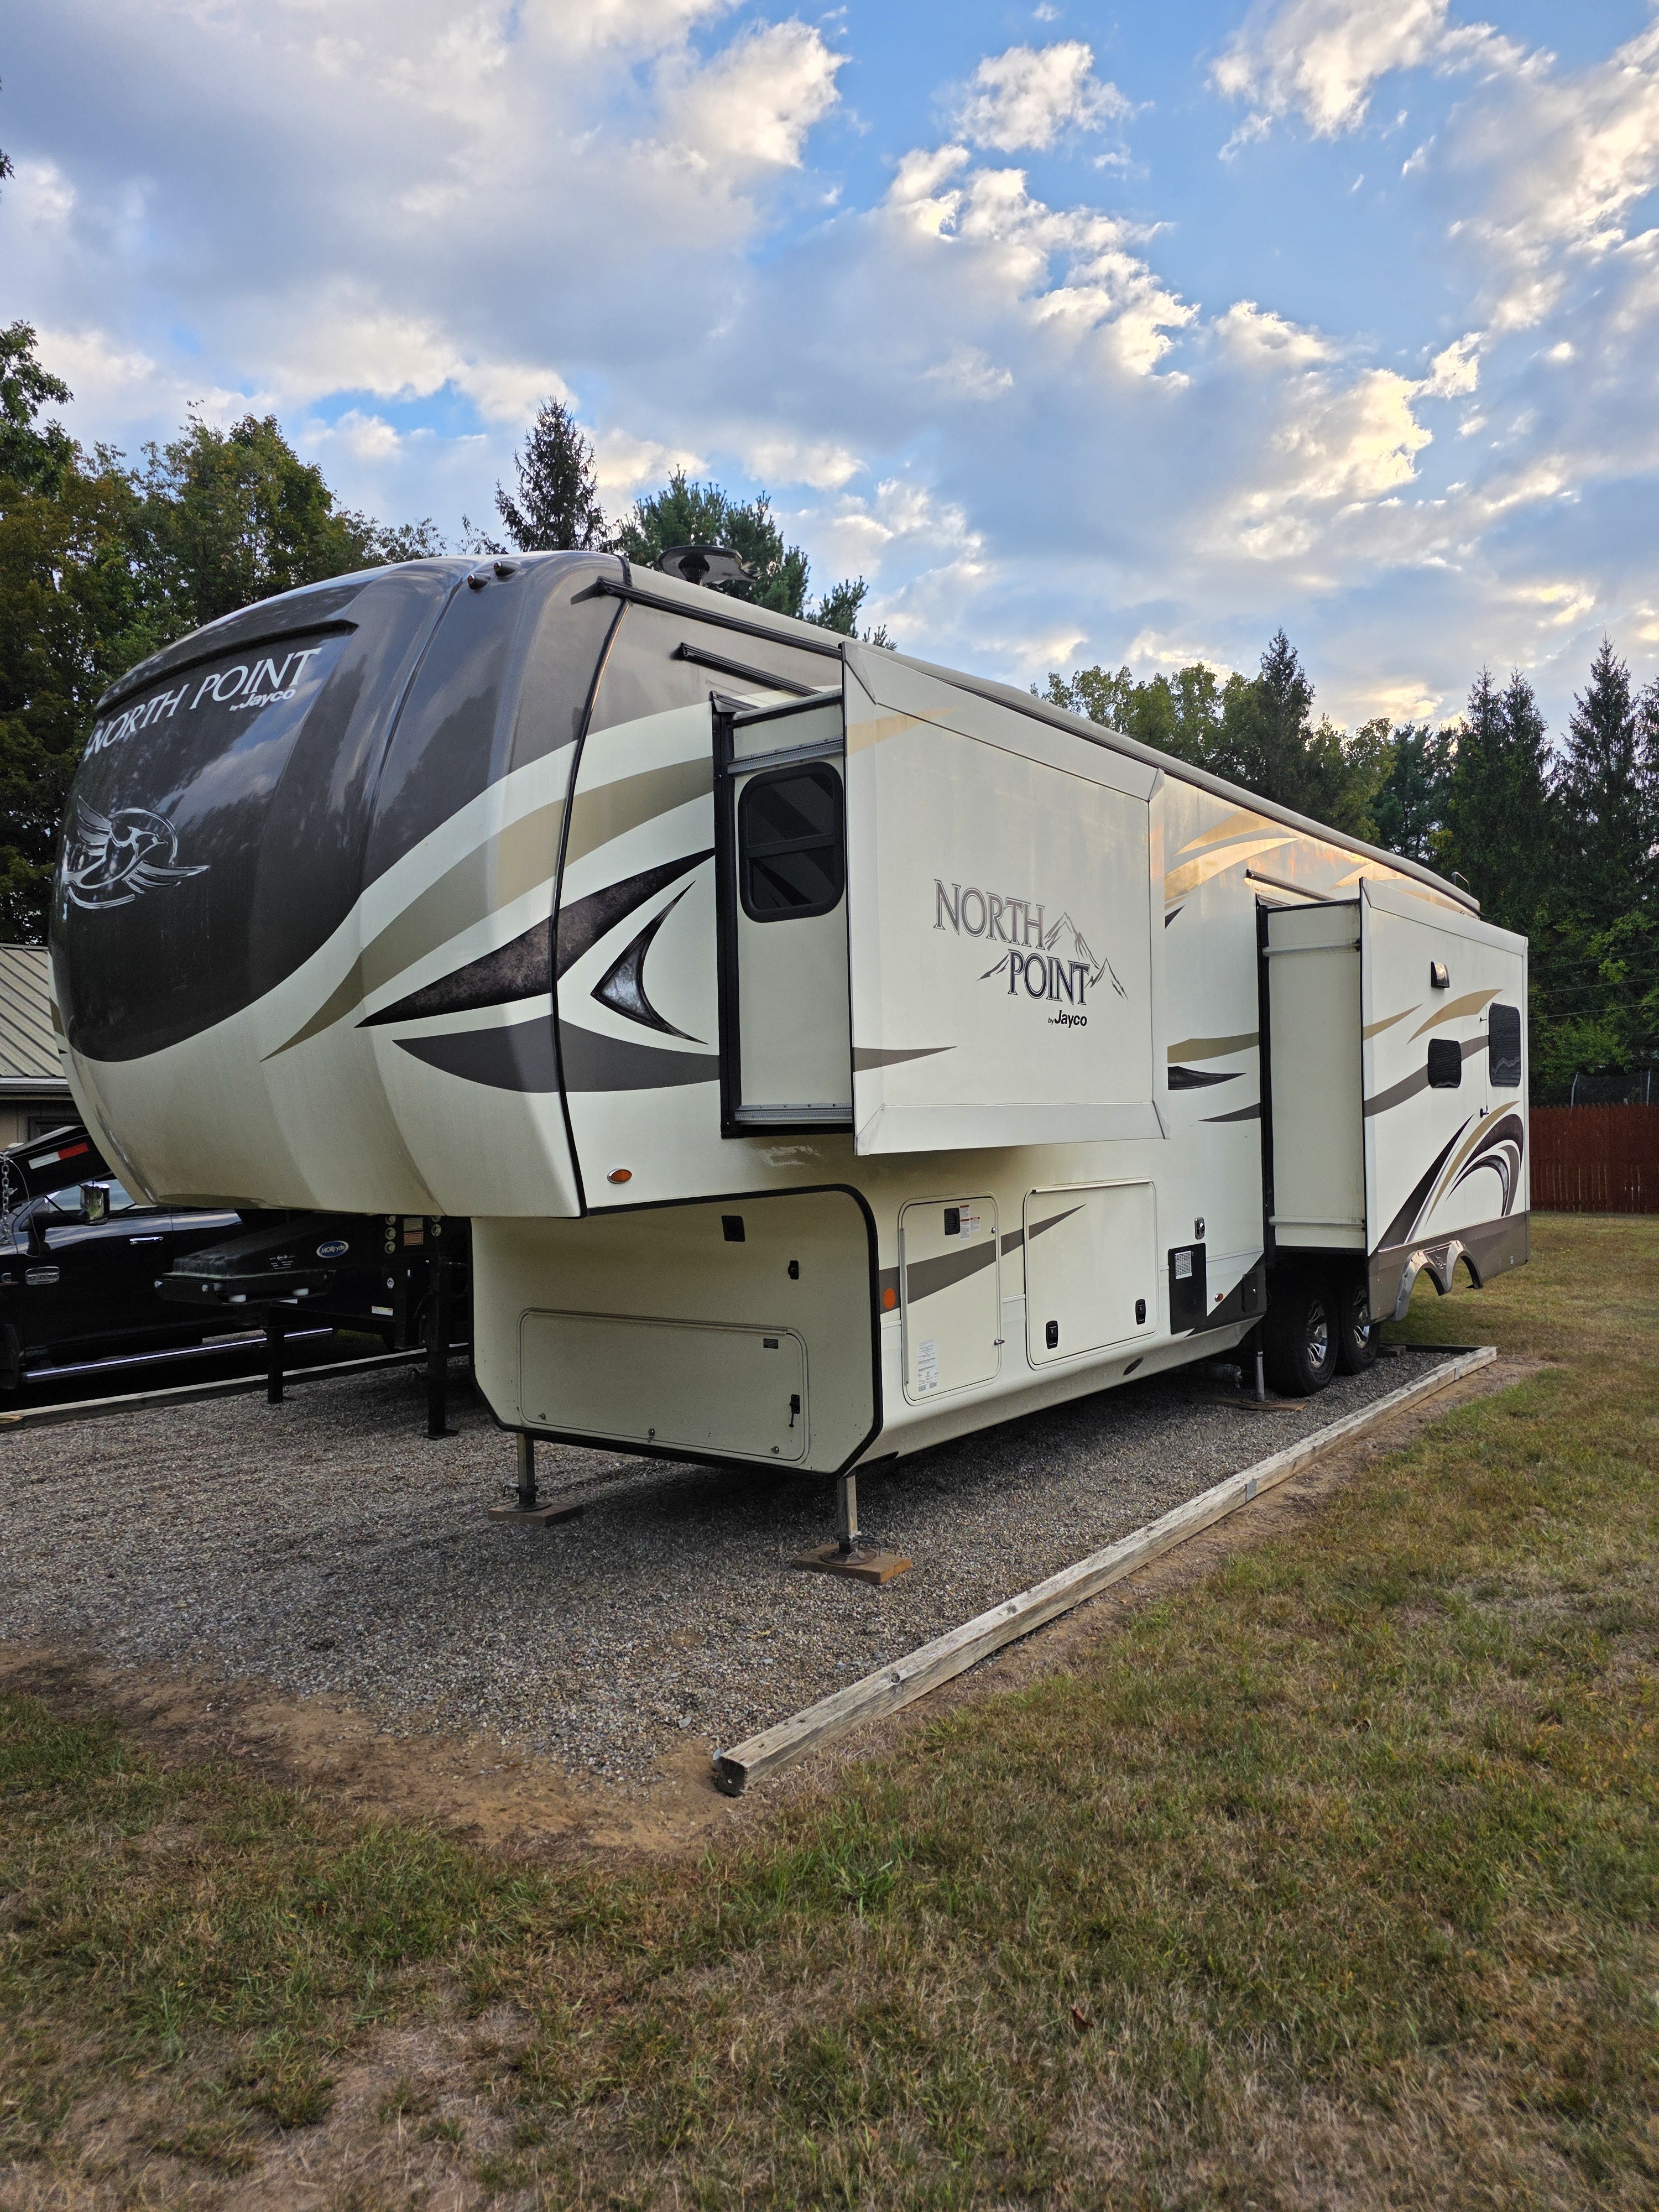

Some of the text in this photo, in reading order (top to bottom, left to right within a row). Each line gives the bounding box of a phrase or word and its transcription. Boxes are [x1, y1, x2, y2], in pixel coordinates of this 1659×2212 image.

[84, 648, 322, 762] NORTH POINT
[239, 689, 296, 708] Jayco
[933, 879, 1045, 951] NORTH
[1008, 948, 1090, 1005] POINT
[1047, 1009, 1087, 1029] by Jayco
